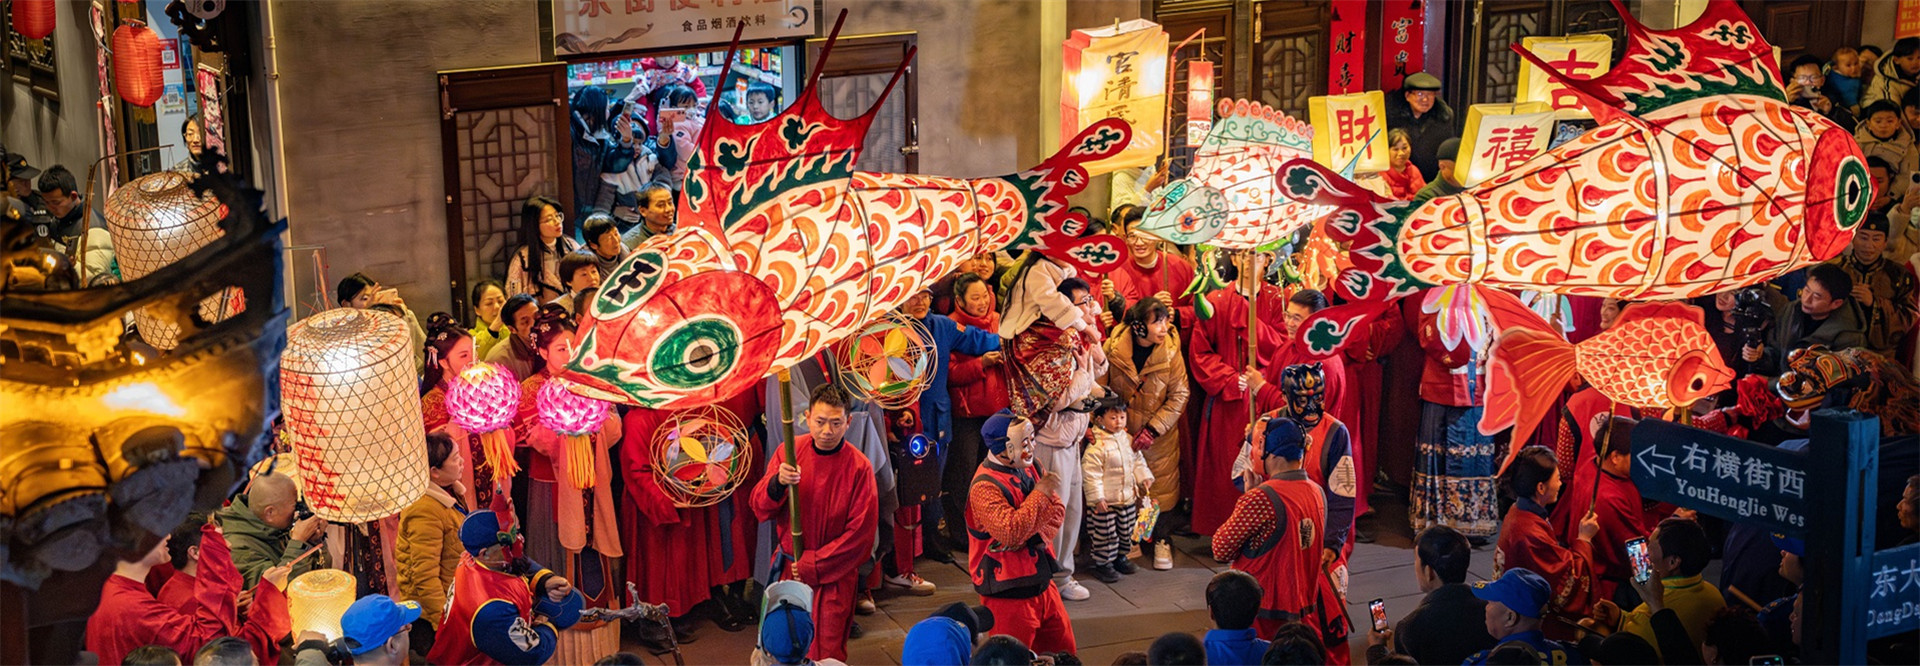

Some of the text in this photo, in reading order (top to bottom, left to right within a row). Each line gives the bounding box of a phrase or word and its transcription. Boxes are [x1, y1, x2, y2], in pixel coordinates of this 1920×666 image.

[681, 14, 766, 32] 食品烟酒饮料
[1547, 48, 1599, 111] 吉
[1481, 124, 1541, 172] 禧
[1680, 442, 1807, 498] 右横街西
[1675, 477, 1768, 517] YouHengJie
[1870, 559, 1920, 599] 东大
